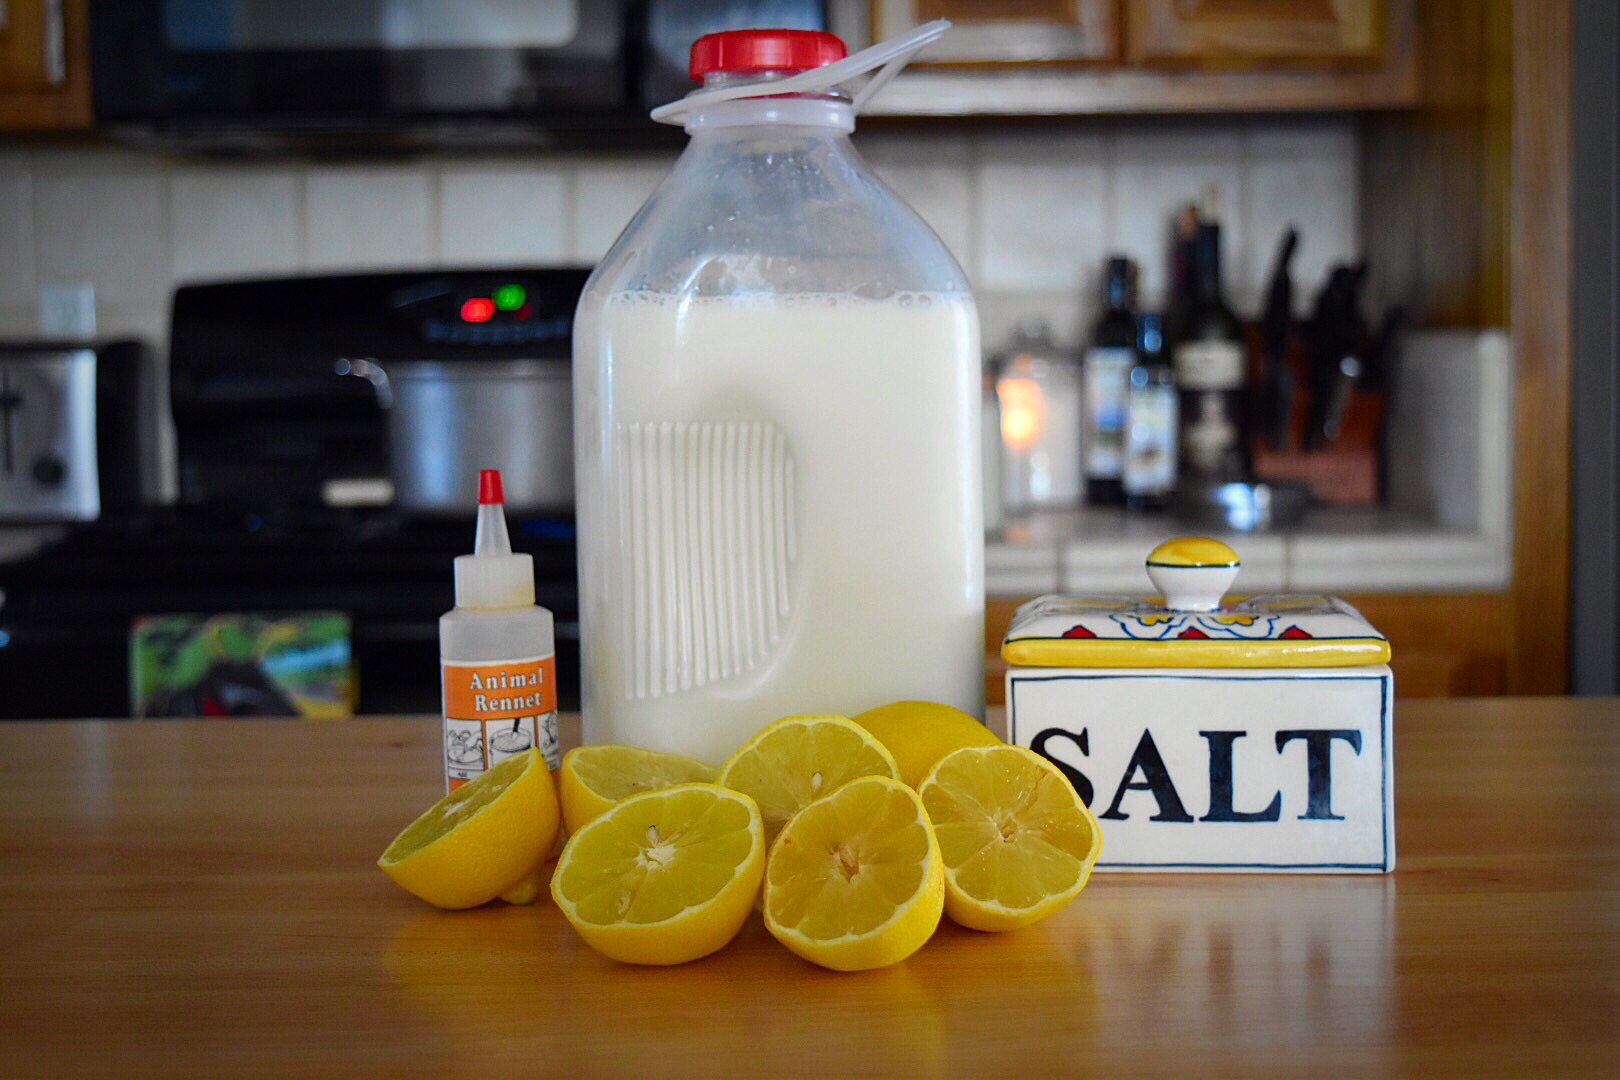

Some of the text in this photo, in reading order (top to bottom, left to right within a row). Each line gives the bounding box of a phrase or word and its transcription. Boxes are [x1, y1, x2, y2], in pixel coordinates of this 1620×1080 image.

[469, 667, 544, 690] Animal
[474, 692, 542, 712] Rennet
[1030, 726, 1363, 823] SALT
